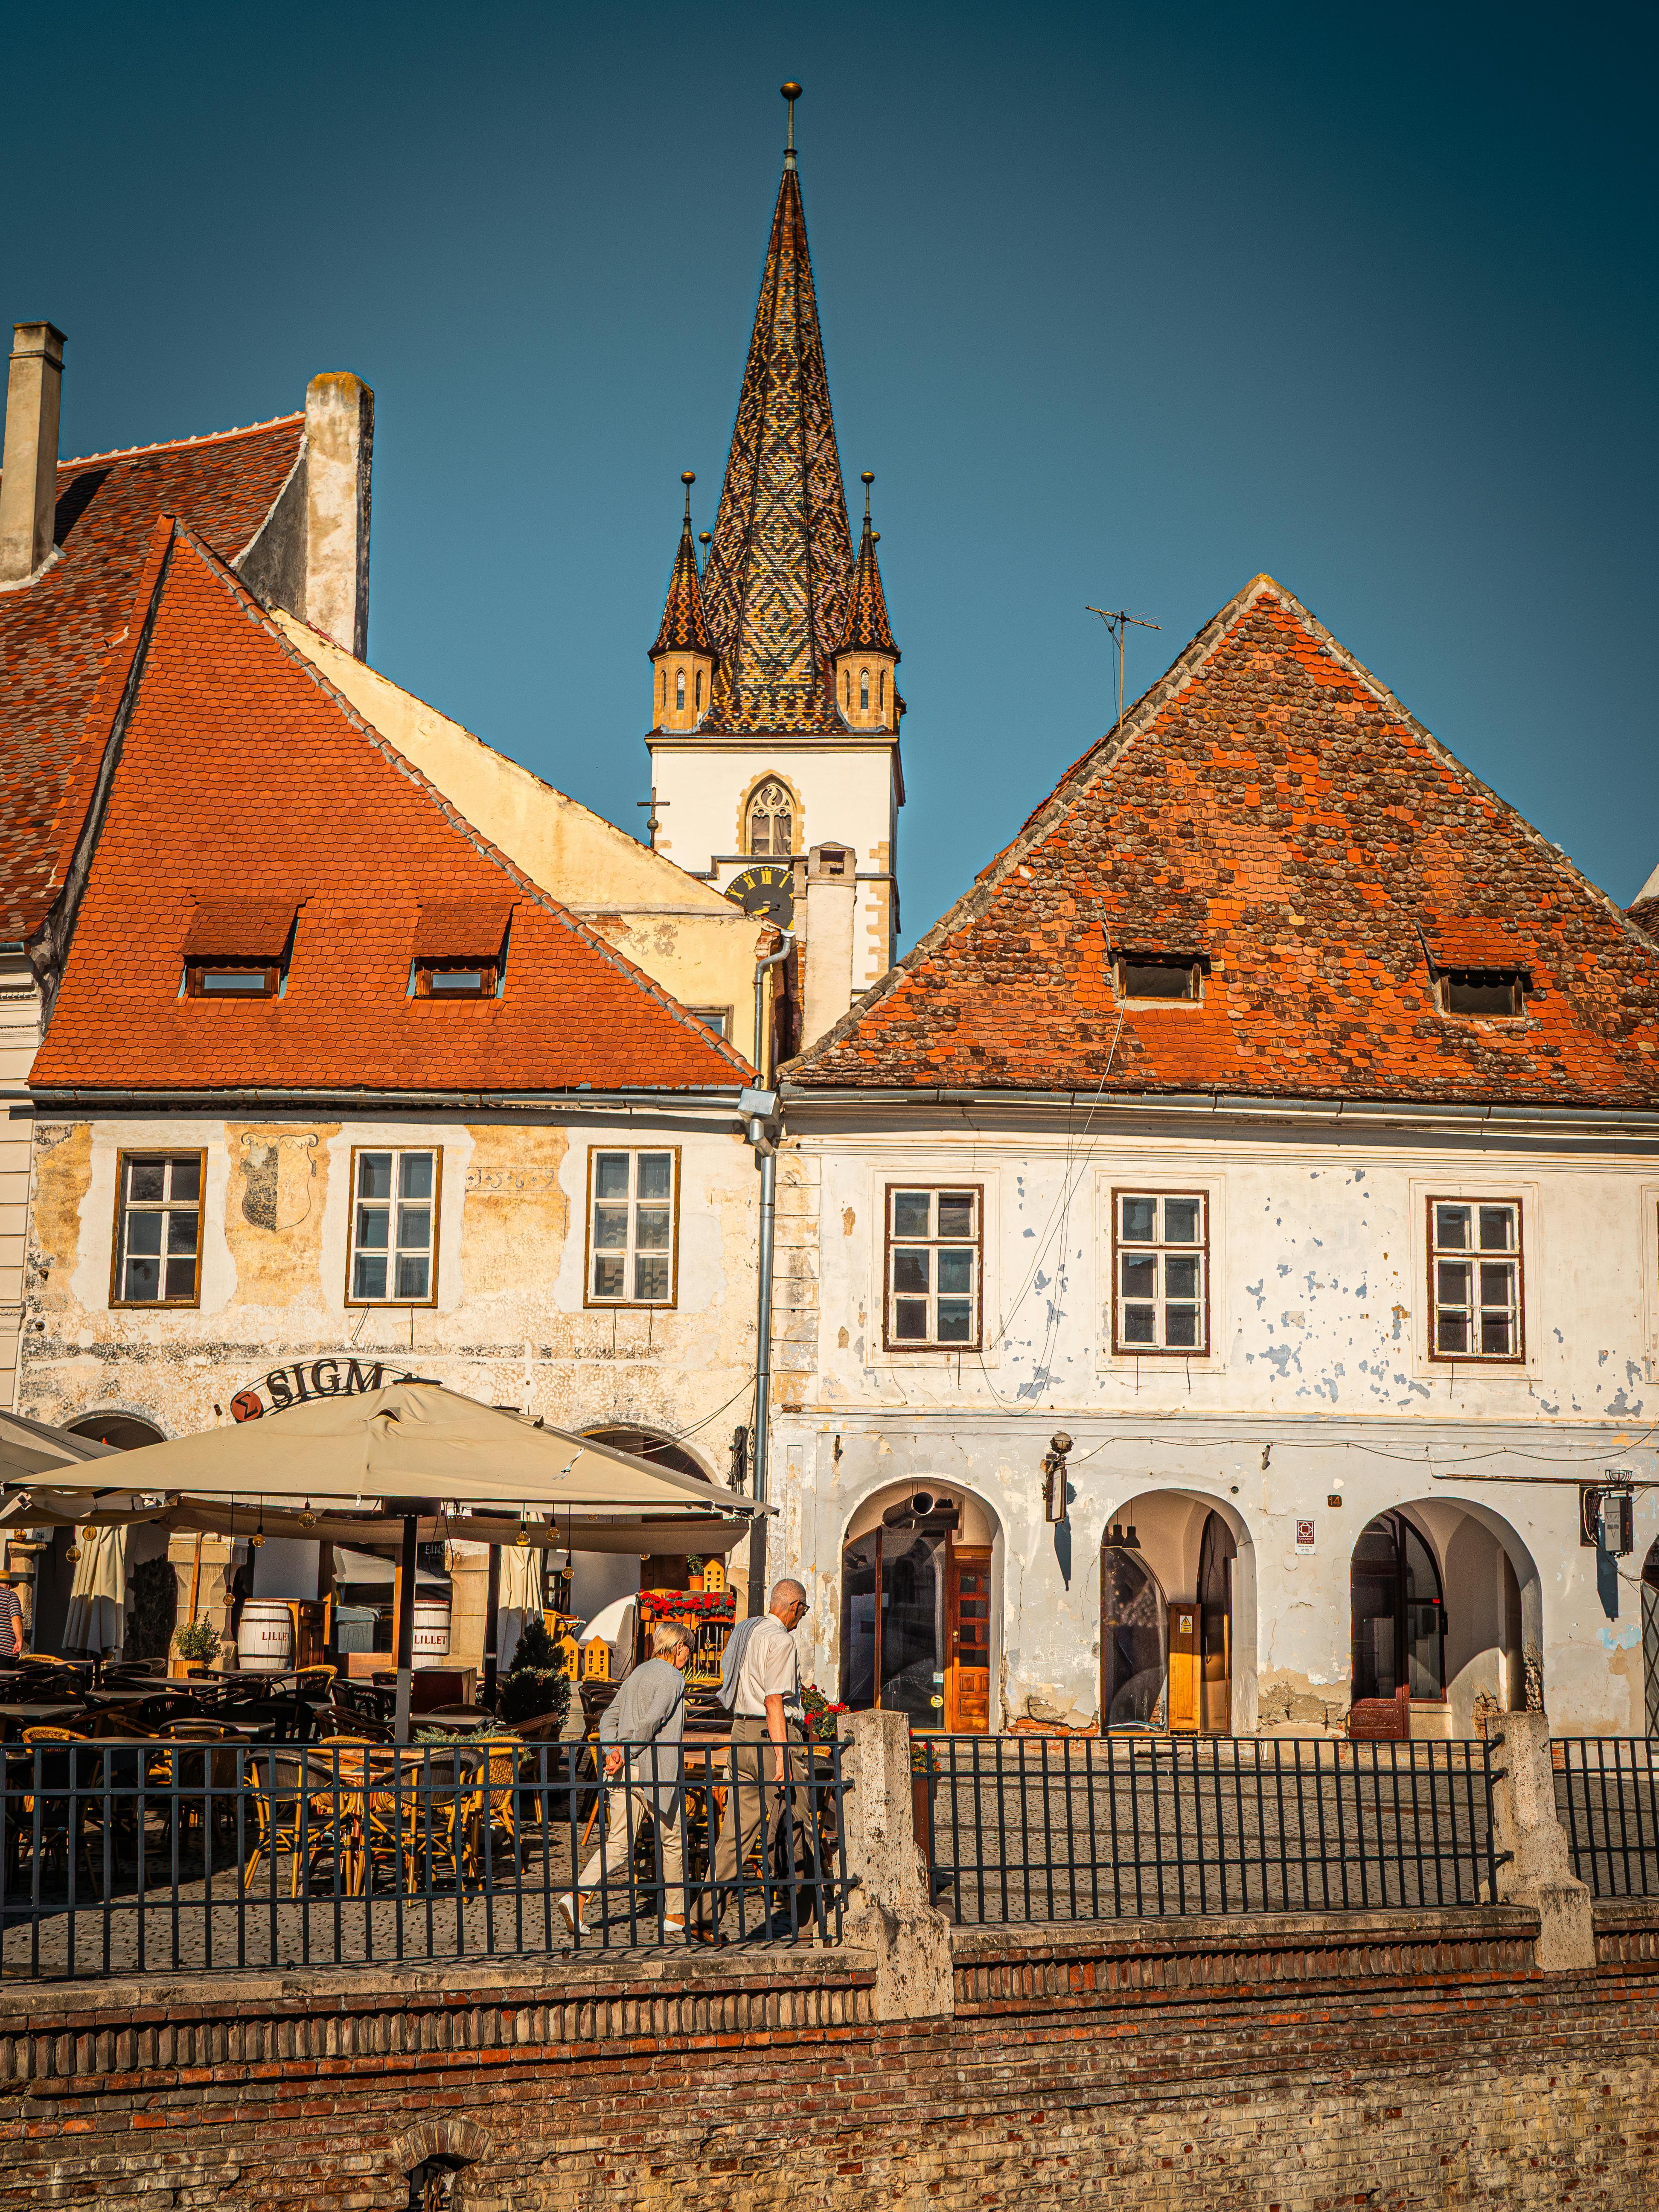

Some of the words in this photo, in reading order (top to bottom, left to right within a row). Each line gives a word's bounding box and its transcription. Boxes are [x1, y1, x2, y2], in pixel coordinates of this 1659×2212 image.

[266, 1358, 412, 1409] SIGM
[1329, 1496, 1340, 1506] 14
[414, 1635, 447, 1645] LILLET
